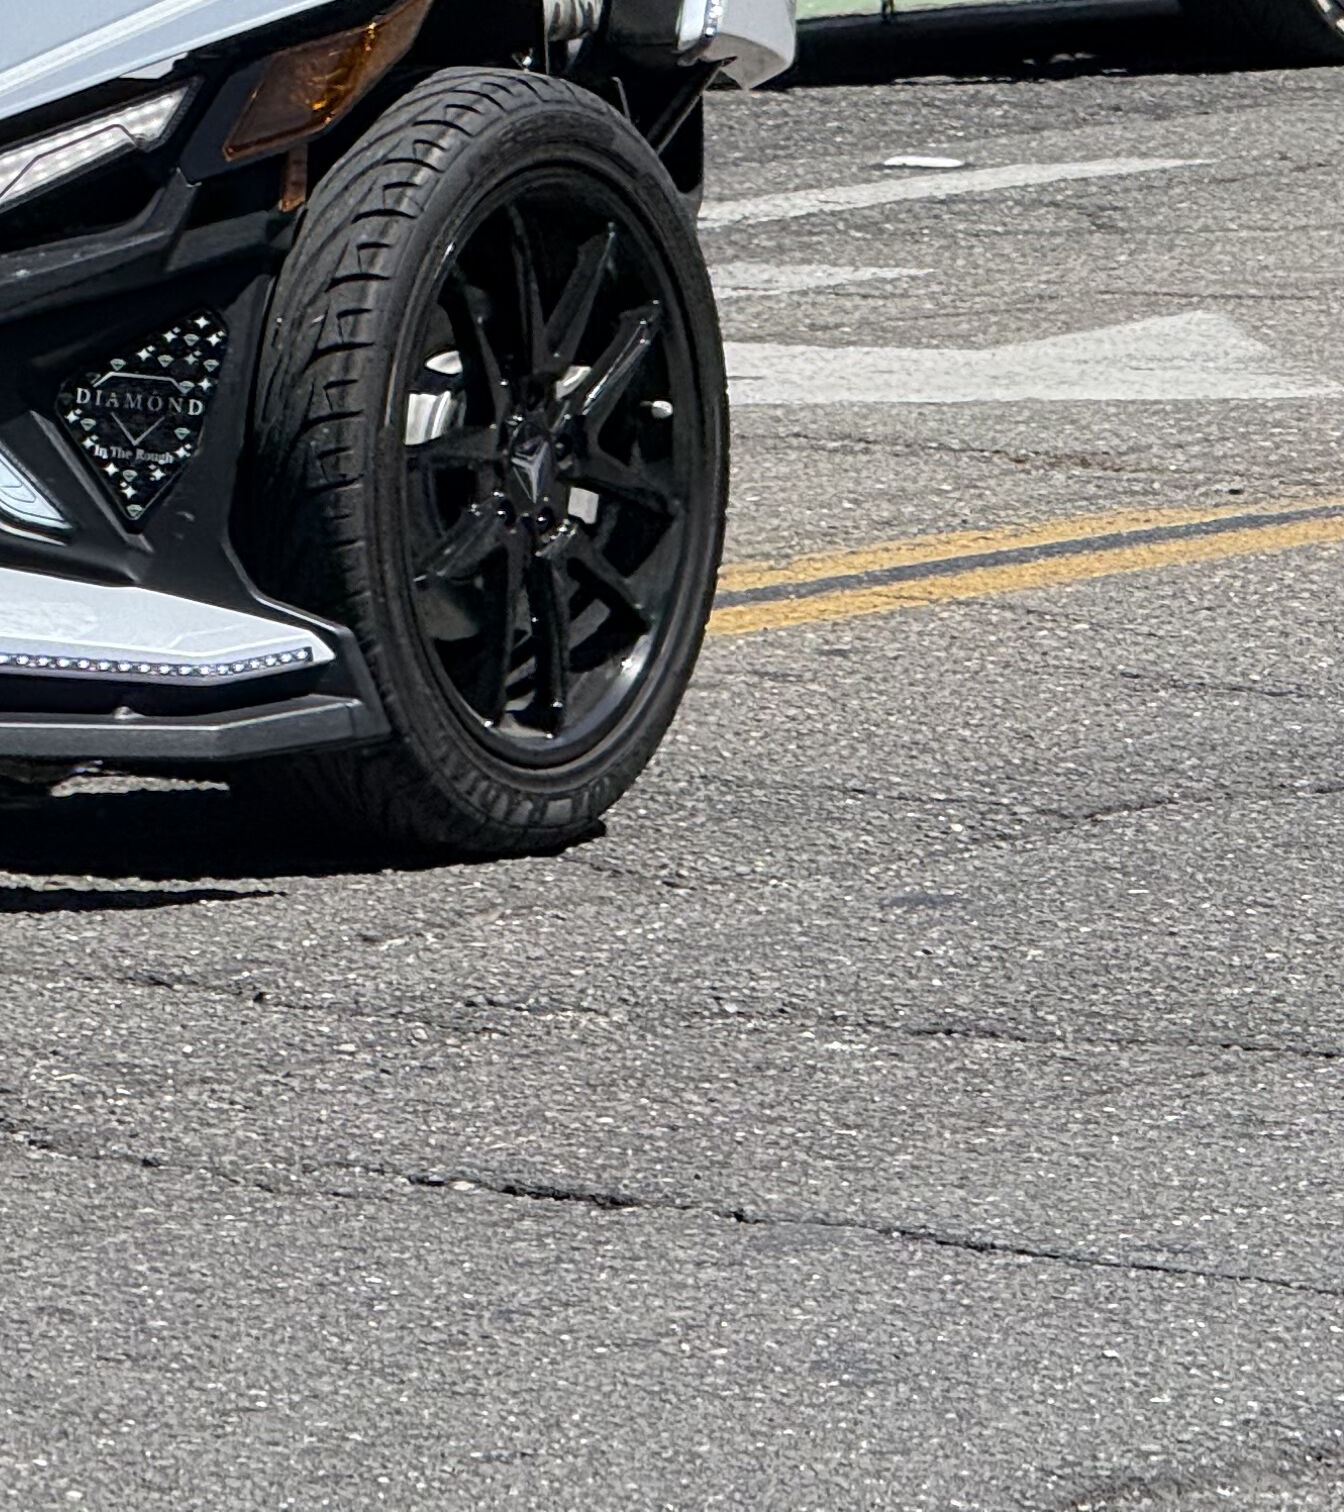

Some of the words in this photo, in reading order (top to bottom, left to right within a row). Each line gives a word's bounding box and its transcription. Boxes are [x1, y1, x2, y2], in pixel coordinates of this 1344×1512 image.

[75, 386, 205, 416] DIAMOND
[93, 444, 109, 460] In
[109, 444, 134, 461] The
[135, 447, 175, 466] Rough
